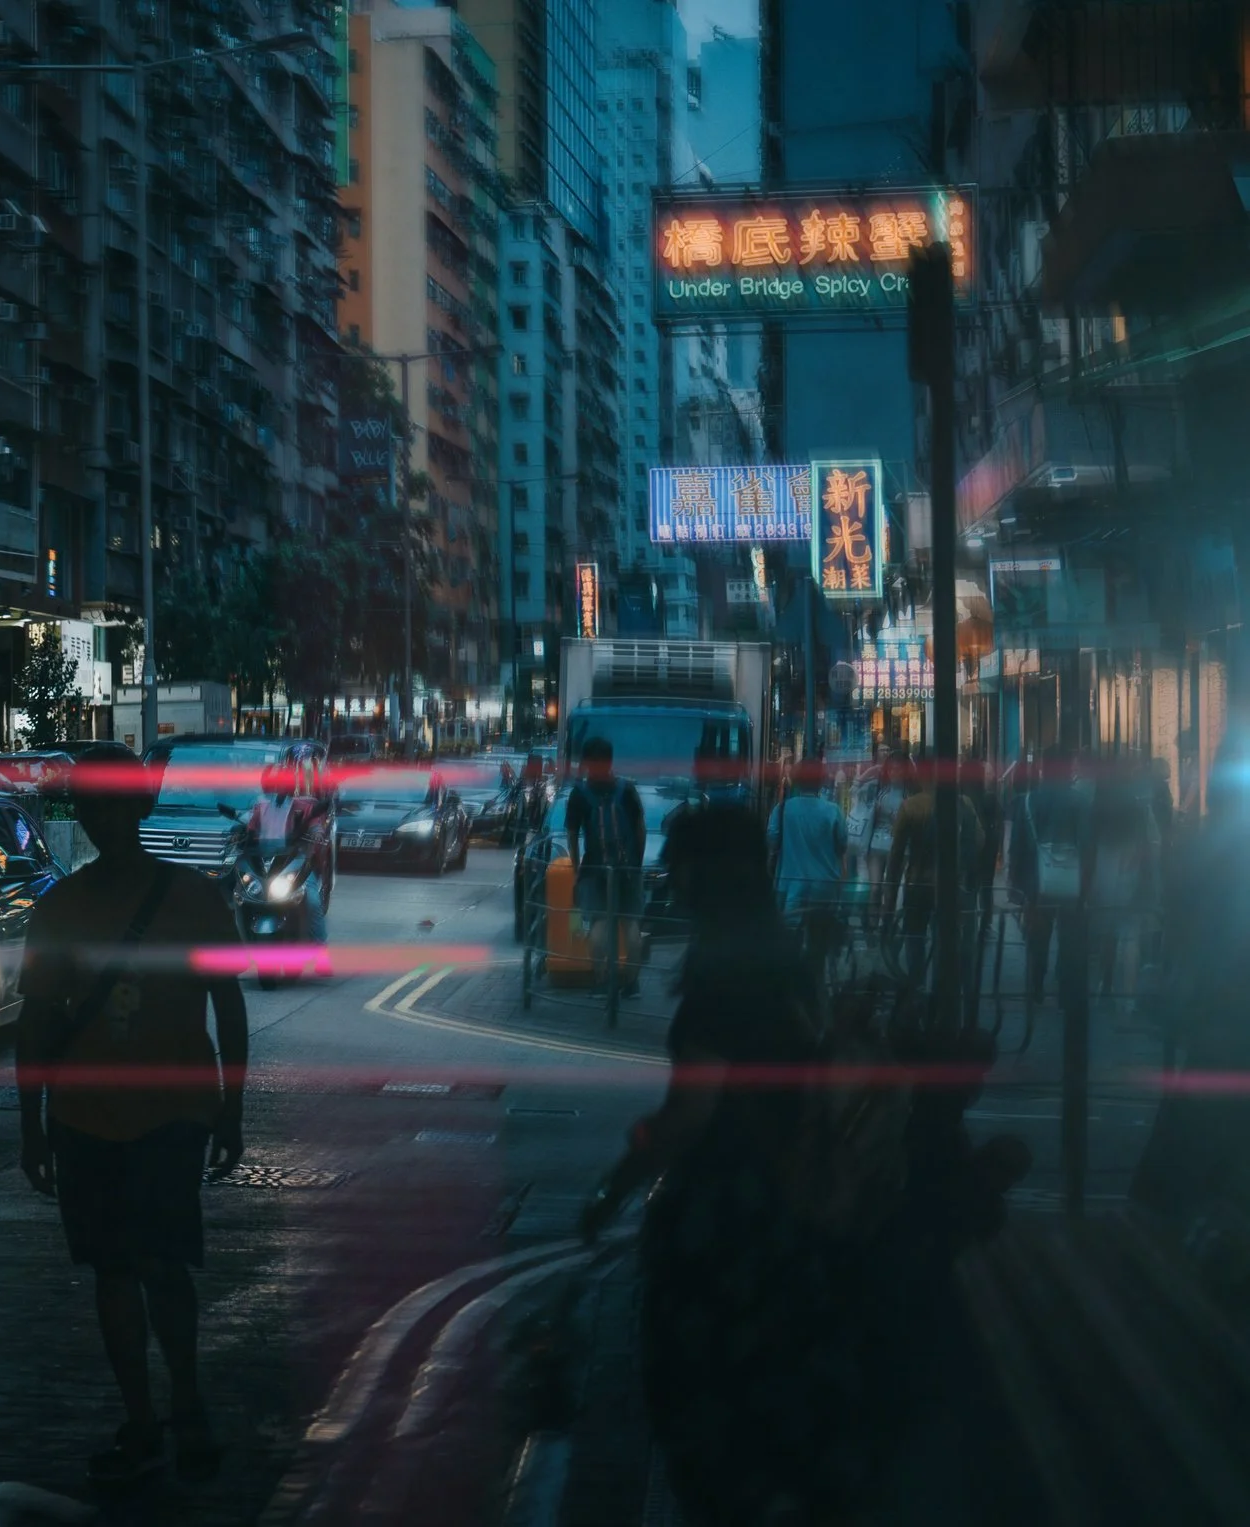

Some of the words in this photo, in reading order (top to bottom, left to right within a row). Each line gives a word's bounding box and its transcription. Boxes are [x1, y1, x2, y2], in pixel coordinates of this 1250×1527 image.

[662, 208, 928, 269] 橋底辣蟹
[668, 277, 732, 299] Under
[740, 276, 804, 300] Bridge
[815, 275, 871, 299] Spicy
[822, 469, 873, 563] 新光
